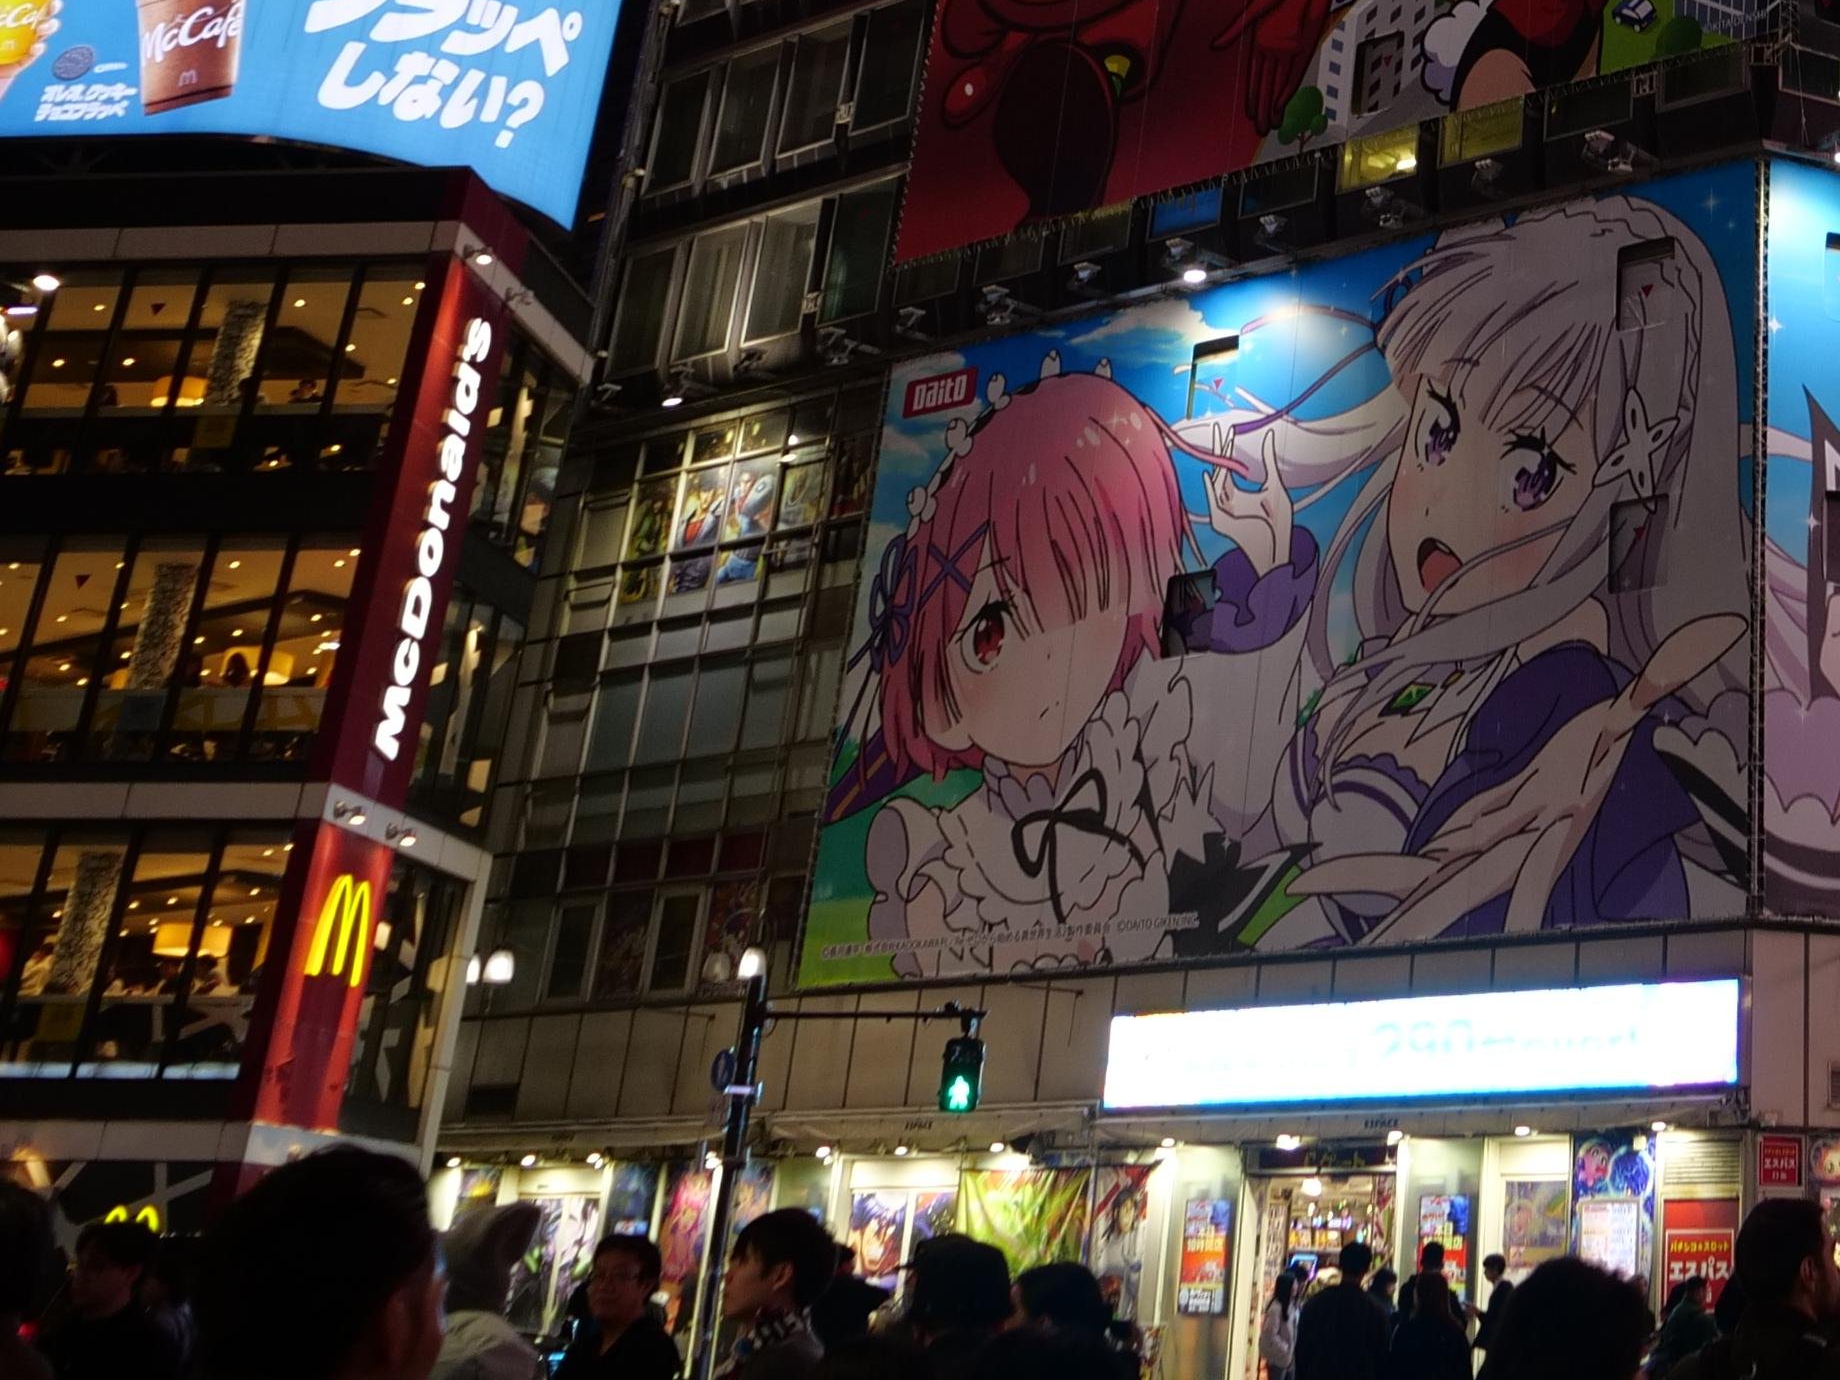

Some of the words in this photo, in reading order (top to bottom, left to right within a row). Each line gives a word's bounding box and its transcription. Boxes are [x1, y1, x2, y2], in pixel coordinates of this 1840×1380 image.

[374, 317, 493, 762] McDonald's
[1763, 1158, 1796, 1169] エスパス
[1668, 1255, 1733, 1280] エスパス
